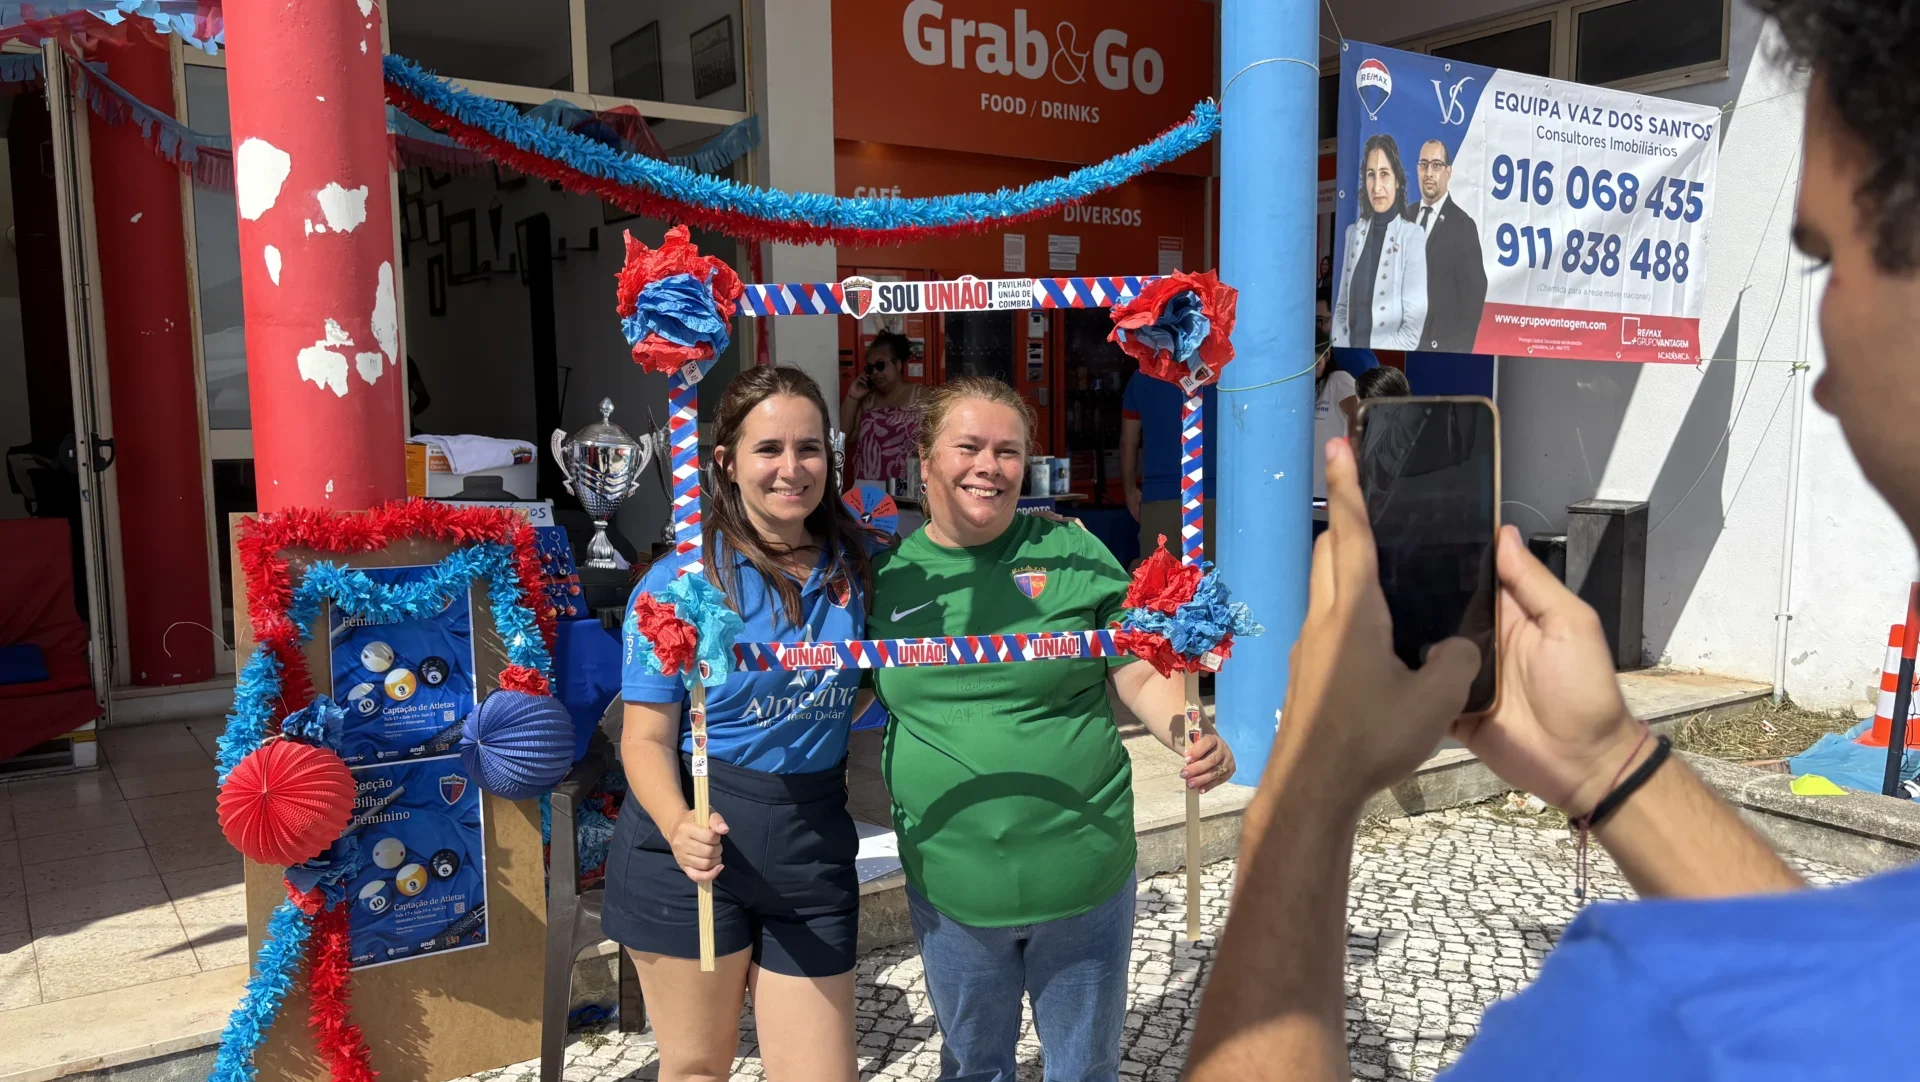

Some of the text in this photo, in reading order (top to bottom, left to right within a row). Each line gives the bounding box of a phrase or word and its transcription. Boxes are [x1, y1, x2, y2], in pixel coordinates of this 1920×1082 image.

[903, 0, 1164, 95] Grab&Go
[1360, 72, 1388, 86] RE/MAX
[980, 93, 1027, 115] FOOD
[1042, 101, 1100, 124] DRINKS
[1495, 91, 1713, 142] EQUIPA VAZ DOS SANTOS
[1536, 125, 1678, 158] Consultores Imobiliários
[1491, 154, 1704, 223] 916 068 435
[1063, 204, 1142, 227] DIVERSOS
[1496, 222, 1690, 284] 911 838 488
[998, 280, 1032, 289] PAVILHÃO
[1567, 285, 1582, 297] para
[879, 276, 994, 313] SOU UNIÃO!
[998, 289, 1032, 299] UNIÃO DE
[998, 300, 1032, 309] COIMBRA
[1495, 314, 1607, 331] www.grupovantagem.com
[1637, 328, 1662, 338] RE/MAX
[787, 635, 1080, 666] UNIÃO! UNIÃO! UNIÃO!
[398, 686, 406, 695] 9
[360, 700, 372, 711] 10
[382, 701, 456, 716] Captação de Atletas
[409, 745, 426, 754] andi
[354, 777, 393, 793] Secção
[353, 795, 391, 809] Bilhar
[353, 810, 411, 826] Feminino
[442, 867, 449, 875] 8
[409, 880, 417, 889] 9
[371, 897, 386, 909] 10
[393, 893, 466, 911] Captação de Atletas
[420, 939, 436, 948] andi
